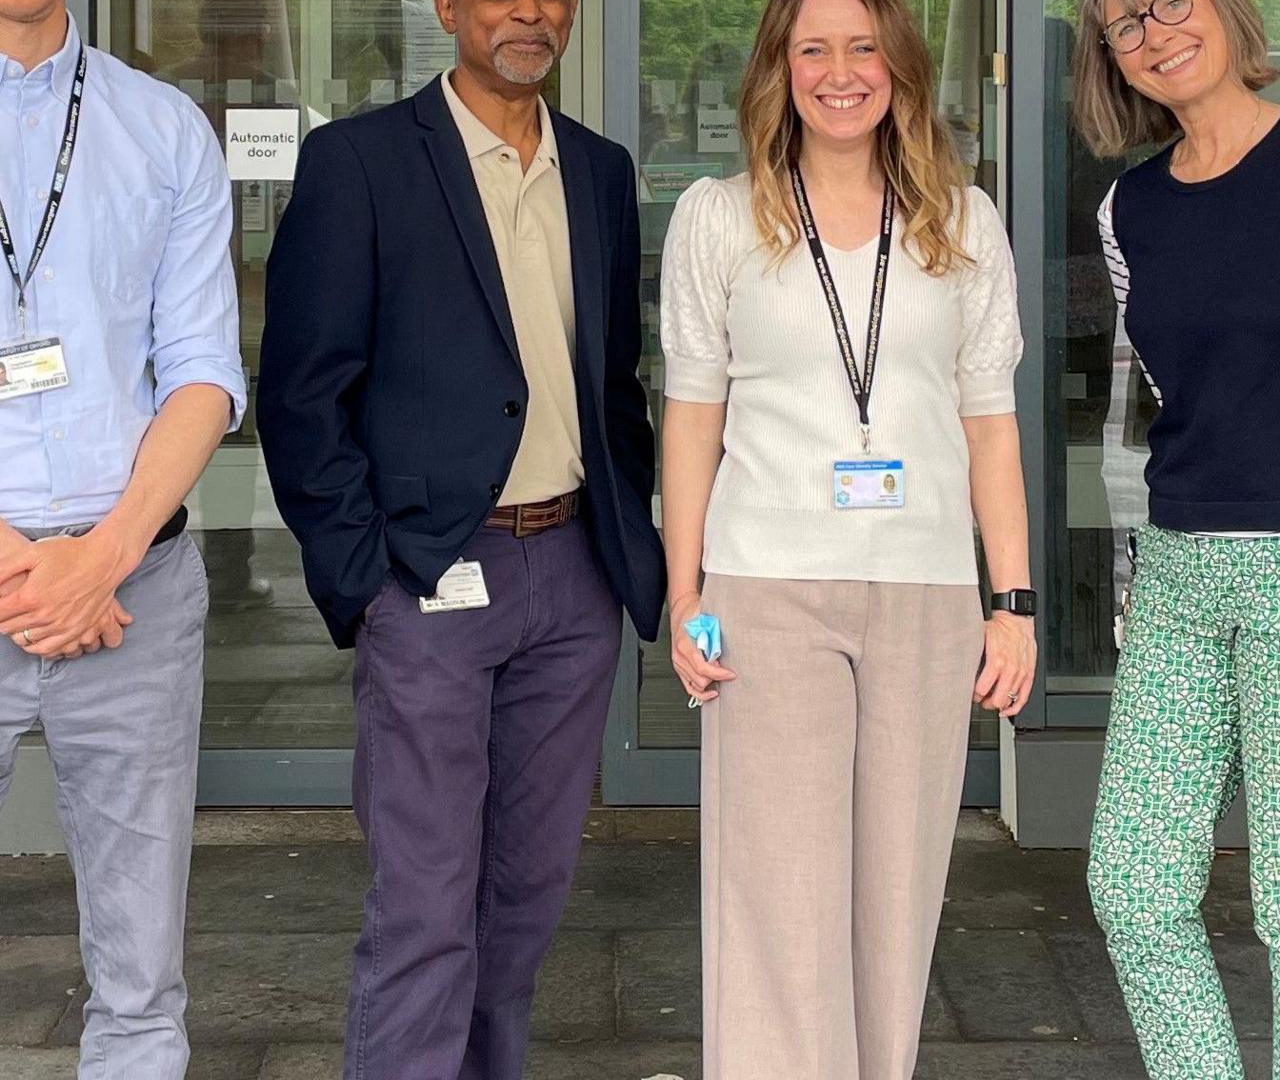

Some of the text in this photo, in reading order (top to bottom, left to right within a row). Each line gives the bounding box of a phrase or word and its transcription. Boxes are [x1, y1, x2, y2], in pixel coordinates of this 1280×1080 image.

[229, 131, 296, 144] Automatic
[60, 140, 73, 166] Oxford
[247, 146, 278, 158] door
